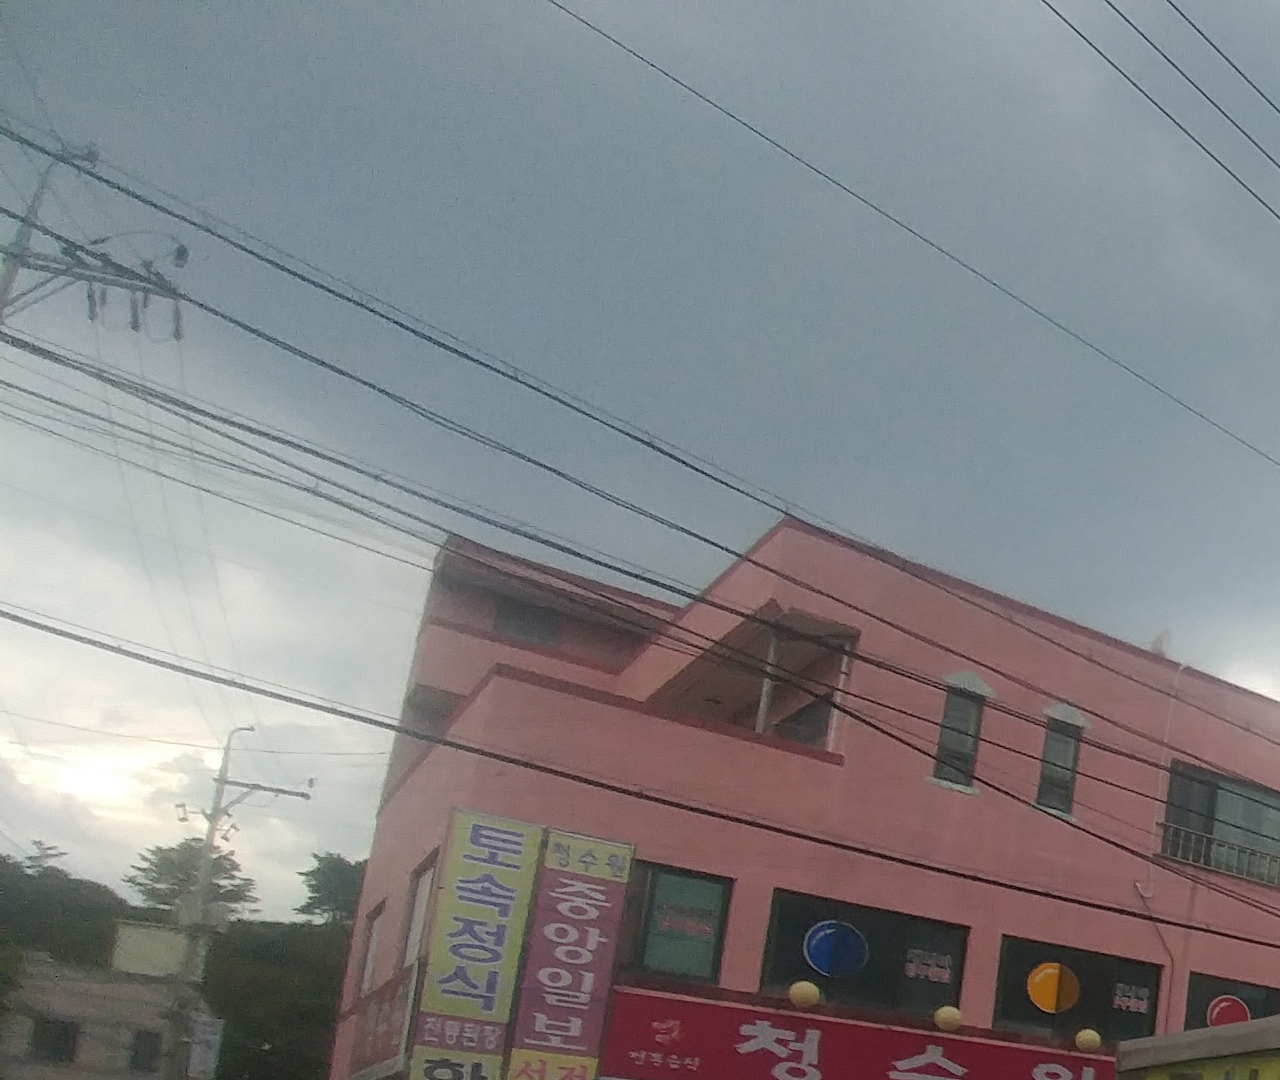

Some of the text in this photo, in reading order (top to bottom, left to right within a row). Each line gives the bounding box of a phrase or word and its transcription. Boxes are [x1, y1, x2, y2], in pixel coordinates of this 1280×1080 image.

[437, 822, 526, 1013] 토속정식
[551, 841, 630, 880] 청수원
[523, 877, 613, 1052] 중앙일보
